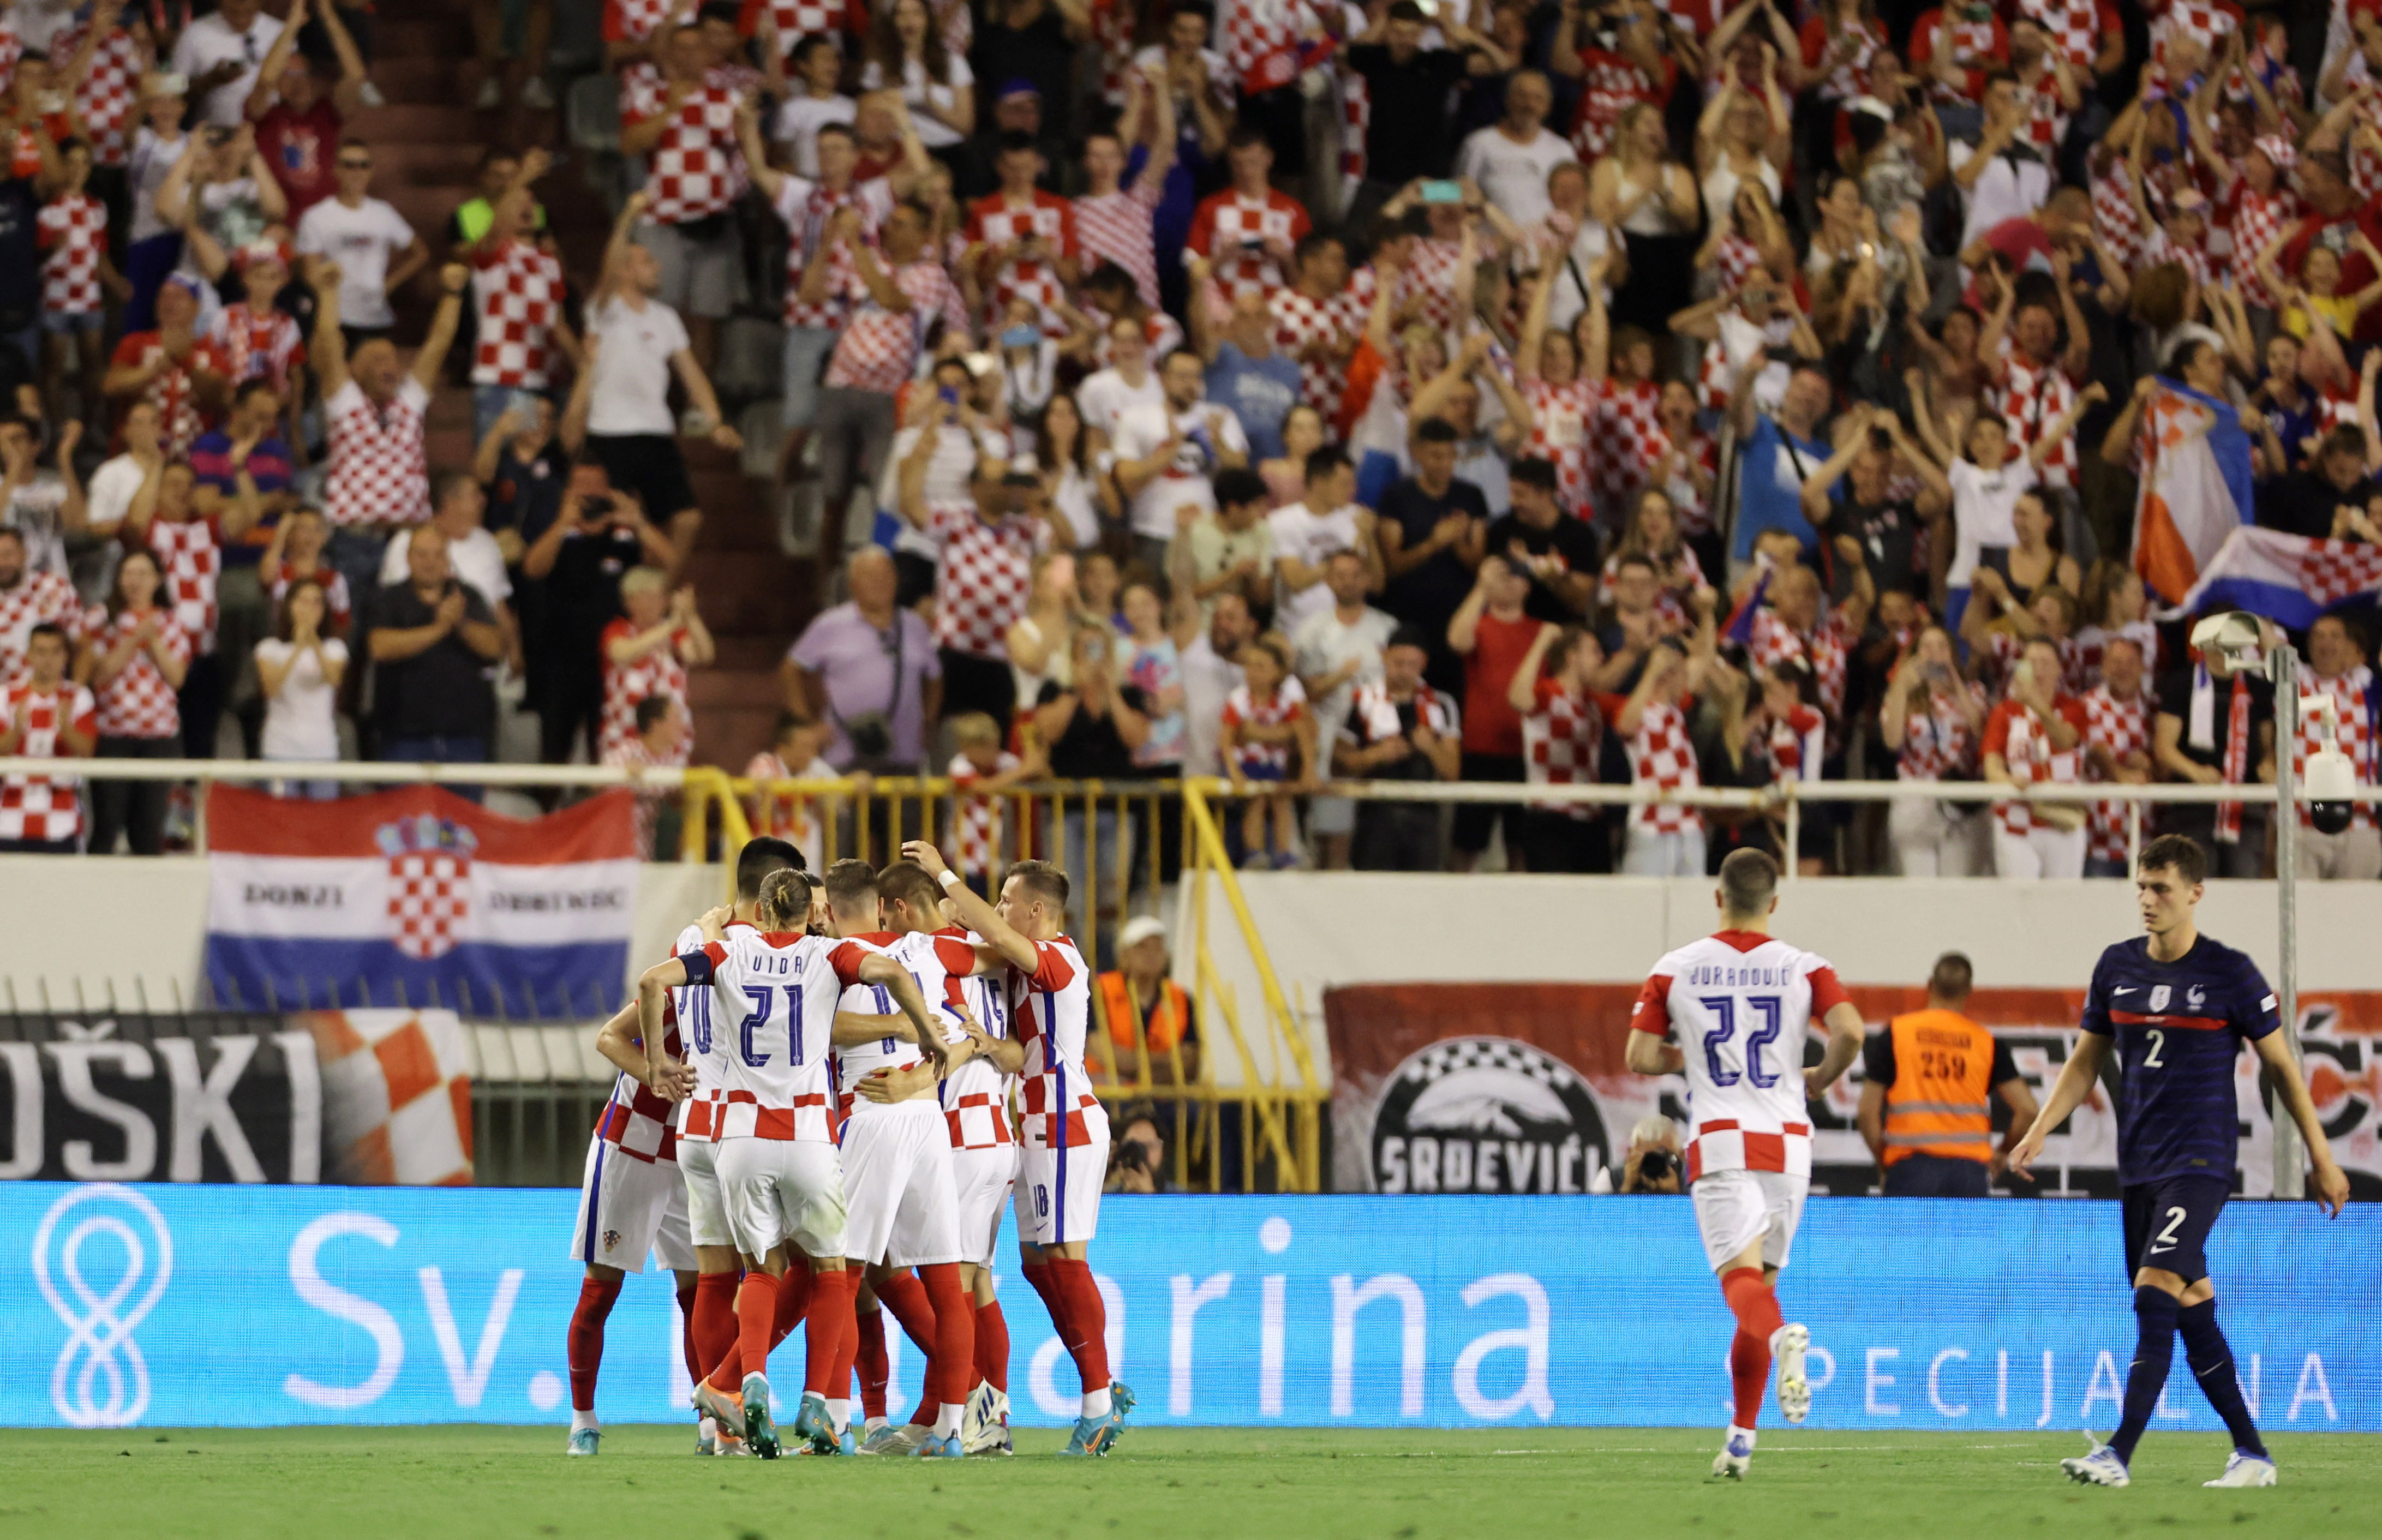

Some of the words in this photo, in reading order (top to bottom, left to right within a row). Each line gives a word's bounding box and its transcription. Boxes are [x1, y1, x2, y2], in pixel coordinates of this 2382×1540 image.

[740, 984, 804, 1068] 21
[1698, 995, 1782, 1089] 22
[2143, 1029, 2165, 1069] 2
[2156, 1205, 2187, 1244] 2
[284, 1211, 565, 1412] Sv.
[671, 1216, 1555, 1421] arina
[1724, 1346, 2337, 1428] PECIJALNA
